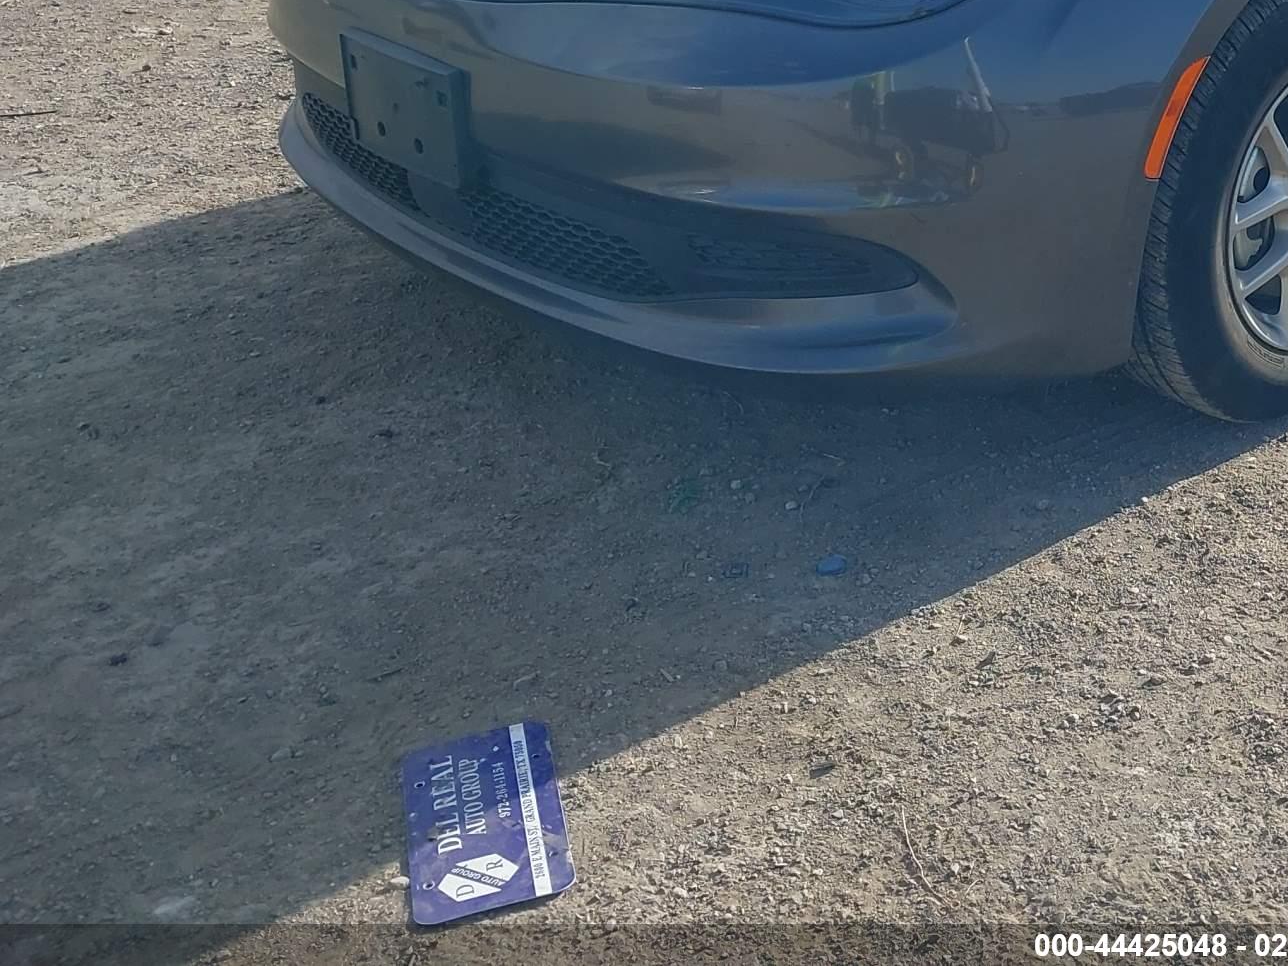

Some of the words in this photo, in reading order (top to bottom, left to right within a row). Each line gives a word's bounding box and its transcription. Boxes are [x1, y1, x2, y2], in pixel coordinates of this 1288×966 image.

[429, 754, 457, 810] REAL
[458, 759, 482, 801] GROUP
[463, 802, 487, 834] AUTO
[522, 798, 536, 823] GRAND
[436, 812, 463, 855] DEL
[450, 867, 482, 880] GROUP
[485, 858, 504, 872] R
[456, 884, 475, 899] D
